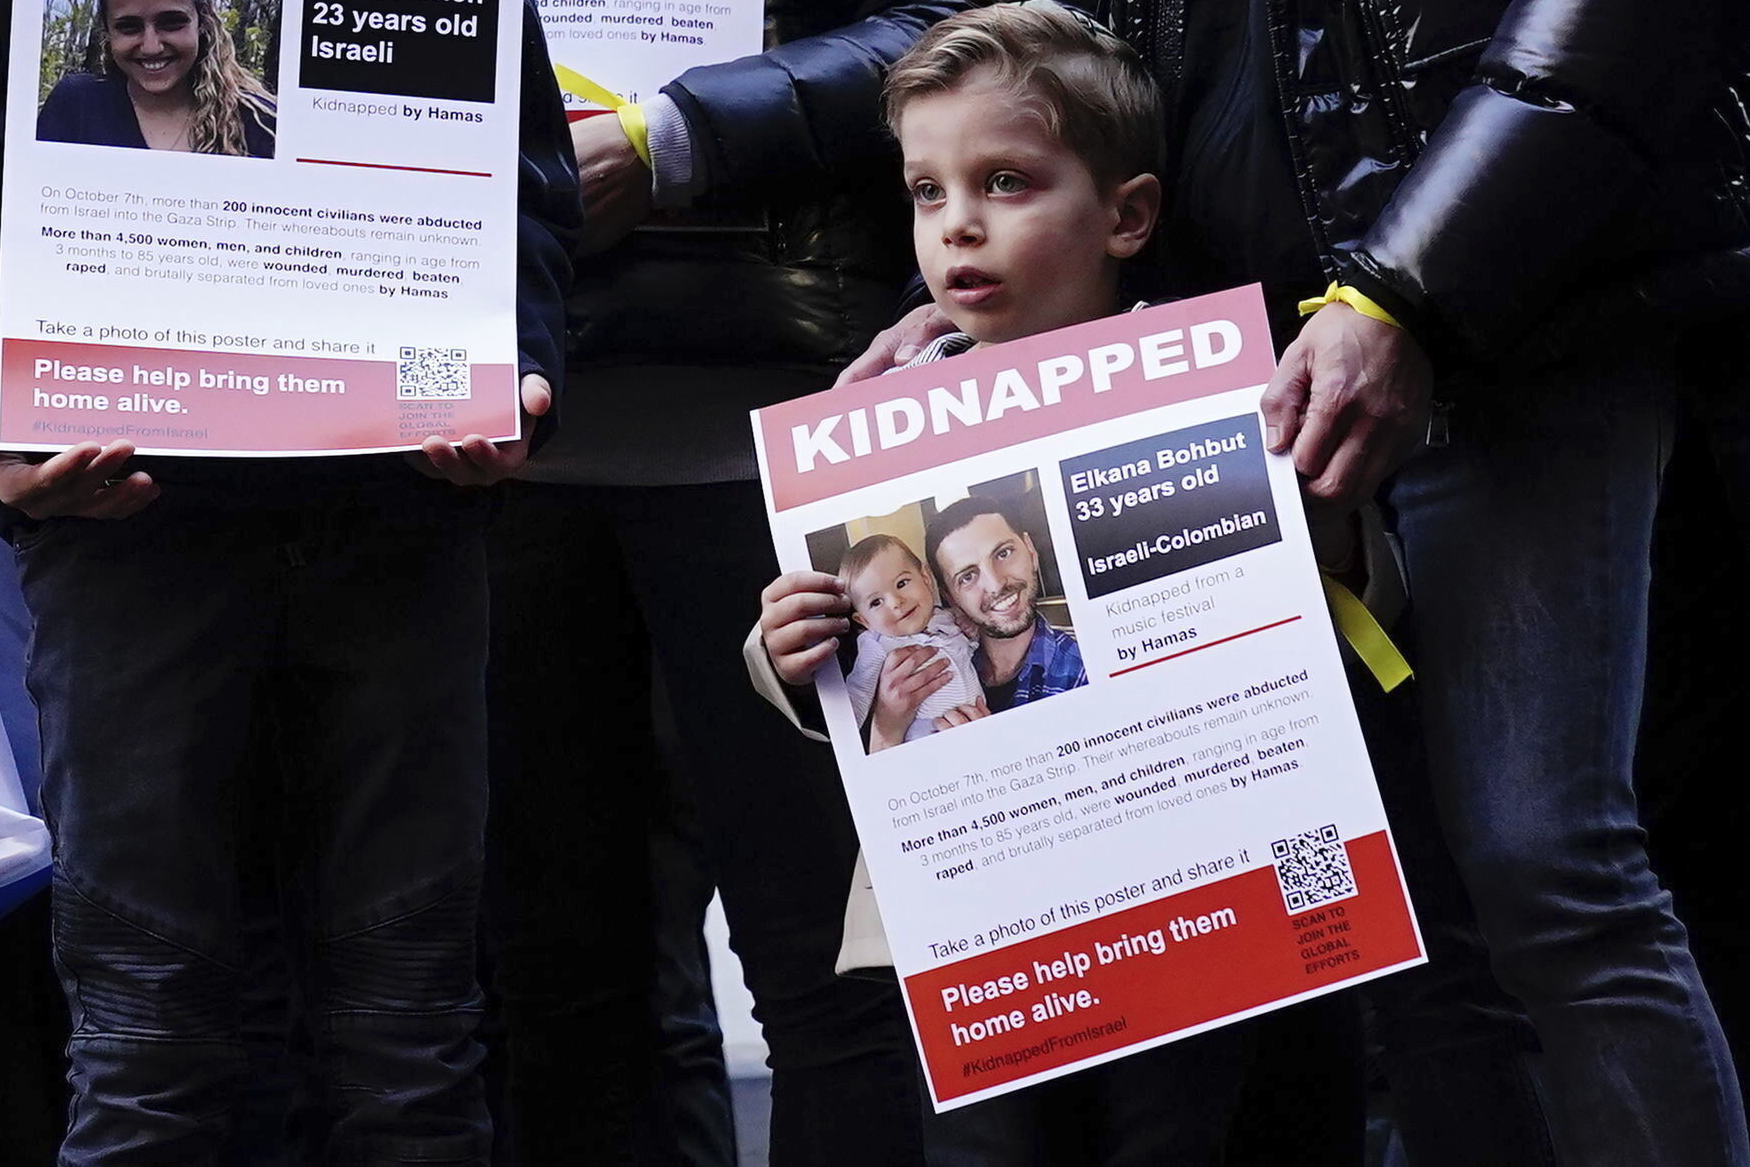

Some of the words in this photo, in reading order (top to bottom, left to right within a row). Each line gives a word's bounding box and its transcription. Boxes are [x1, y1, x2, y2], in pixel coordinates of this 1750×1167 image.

[311, 1, 344, 26] 23
[351, 9, 427, 33] years
[434, 13, 477, 37] old
[311, 34, 393, 64] Israeli
[312, 97, 397, 116] Kidnapped
[402, 103, 423, 121] by
[427, 105, 483, 123] Hamas
[791, 320, 1242, 472] KIDNAPPED
[1070, 458, 1152, 494] Elkana
[1156, 431, 1247, 470] Bohbut
[1075, 496, 1105, 521] 33
[1108, 480, 1176, 516] years
[1180, 463, 1220, 490] old
[1088, 511, 1266, 574] Israeli-Colombian
[1104, 579, 1191, 618] Kidnapped
[1194, 570, 1231, 590] from
[1234, 566, 1245, 579] a
[1110, 615, 1157, 640] music
[1160, 594, 1215, 624] festival
[1116, 645, 1137, 661] by
[1140, 627, 1198, 653] Hamas
[888, 798, 906, 811] On
[909, 781, 959, 804] October
[990, 762, 1022, 776] more
[1025, 751, 1054, 767] than
[1055, 739, 1081, 758] 200
[1082, 720, 1144, 749] innocent
[1145, 703, 1204, 729] civilians
[1205, 692, 1240, 710] were
[1243, 668, 1309, 699] abducted
[927, 938, 969, 959] Take
[973, 933, 986, 947] a
[988, 917, 1036, 946] photo
[1039, 906, 1056, 926] of
[1059, 899, 1091, 920] this
[1093, 882, 1146, 914] poster
[1150, 867, 1183, 892] and
[1186, 855, 1235, 881] share
[1237, 848, 1251, 864] it
[1291, 909, 1327, 930] SCAN
[1325, 904, 1346, 919] TO
[1296, 927, 1325, 945] JOIN
[1325, 919, 1352, 935] THE
[1299, 936, 1351, 960] GLOBAL
[940, 971, 1029, 1012] Please
[1032, 951, 1091, 984] help
[1094, 928, 1166, 965] bring
[1168, 907, 1237, 942] them
[1305, 948, 1360, 974] EFFORTS
[950, 1009, 1025, 1046] home
[1030, 989, 1100, 1022] alive.
